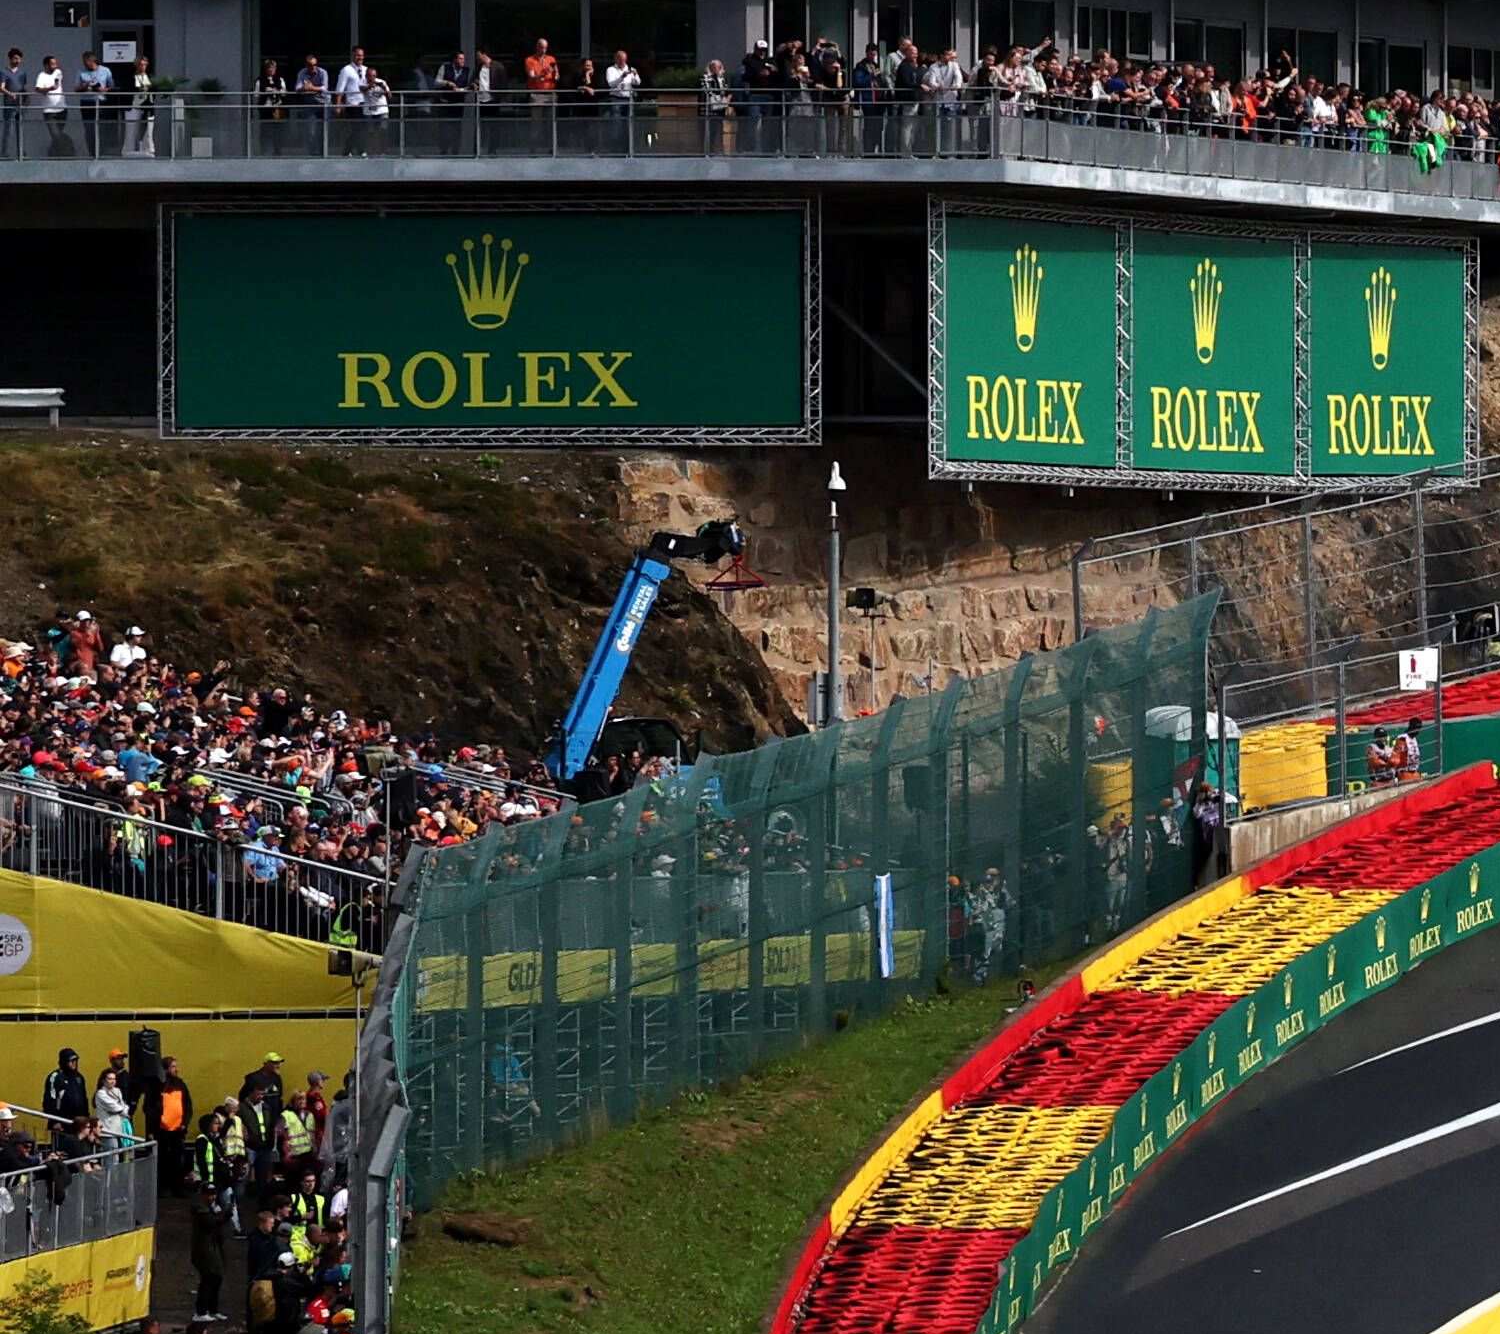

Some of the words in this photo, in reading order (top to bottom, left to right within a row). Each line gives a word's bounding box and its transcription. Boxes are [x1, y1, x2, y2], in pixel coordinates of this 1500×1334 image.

[68, 7, 75, 24] 1
[338, 350, 638, 411] ROLEX
[966, 375, 1085, 446] ROLEX
[1150, 385, 1264, 454] ROLEX
[1328, 393, 1435, 456] ROLEX
[1457, 898, 1494, 933] ROLEX
[4, 934, 23, 943] SPA
[5, 944, 23, 956] GP
[1409, 925, 1441, 960] ROLEX
[1364, 953, 1399, 989] ROLEX
[1319, 981, 1345, 1017] ROLEX
[1275, 1010, 1304, 1047] ROLEX
[1238, 1039, 1262, 1075] ROLEX
[1081, 1196, 1103, 1237] RLEX
